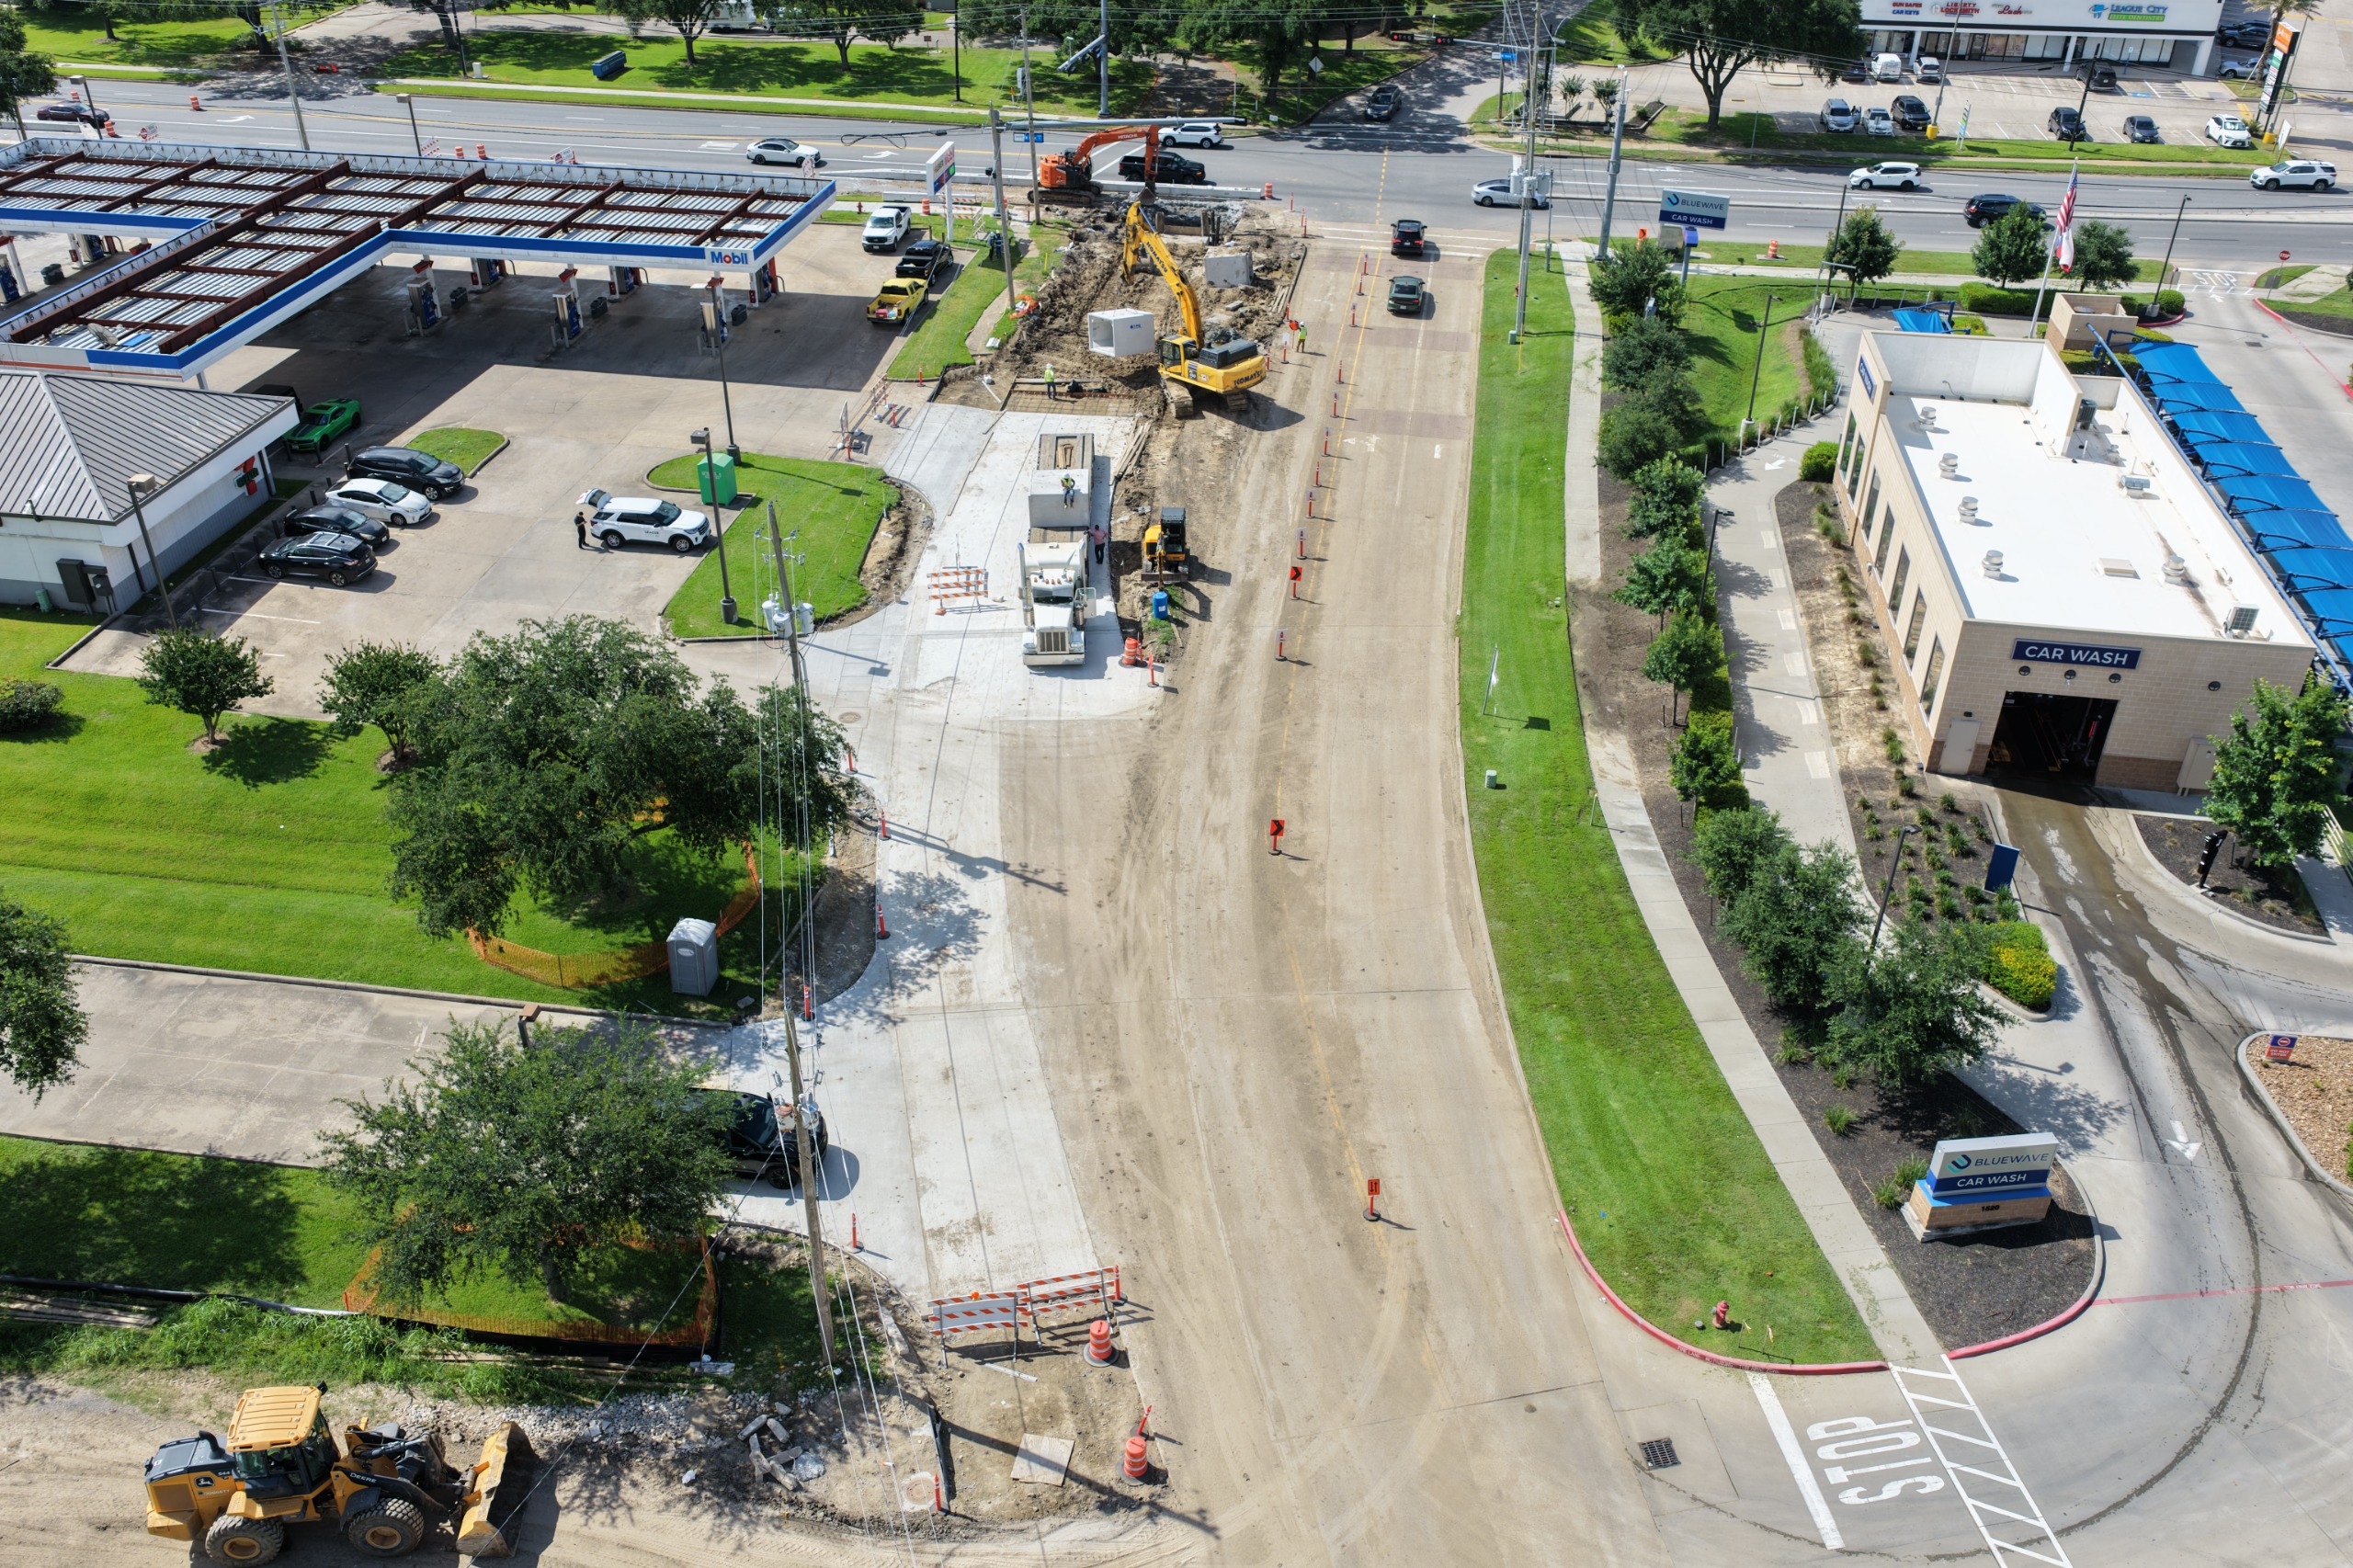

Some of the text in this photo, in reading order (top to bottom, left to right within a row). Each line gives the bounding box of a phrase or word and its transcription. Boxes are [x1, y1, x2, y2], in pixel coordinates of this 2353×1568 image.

[2110, 5, 2168, 14] LEAGUE CITY
[1681, 199, 1724, 210] BLUEWAVE
[1671, 213, 1713, 225] CAR WASH
[710, 251, 749, 265] Mobil
[1146, 241, 1168, 273] KOMATSU
[2192, 272, 2237, 287] STOP
[2025, 646, 2129, 665] CAR WASH
[1974, 1153, 2050, 1166] BLUEWAVE
[1957, 1174, 2027, 1187] CAR WASH
[1981, 1204, 2000, 1212] 1520
[1806, 1416, 1945, 1505] STOP
[349, 1471, 377, 1483] DEERE
